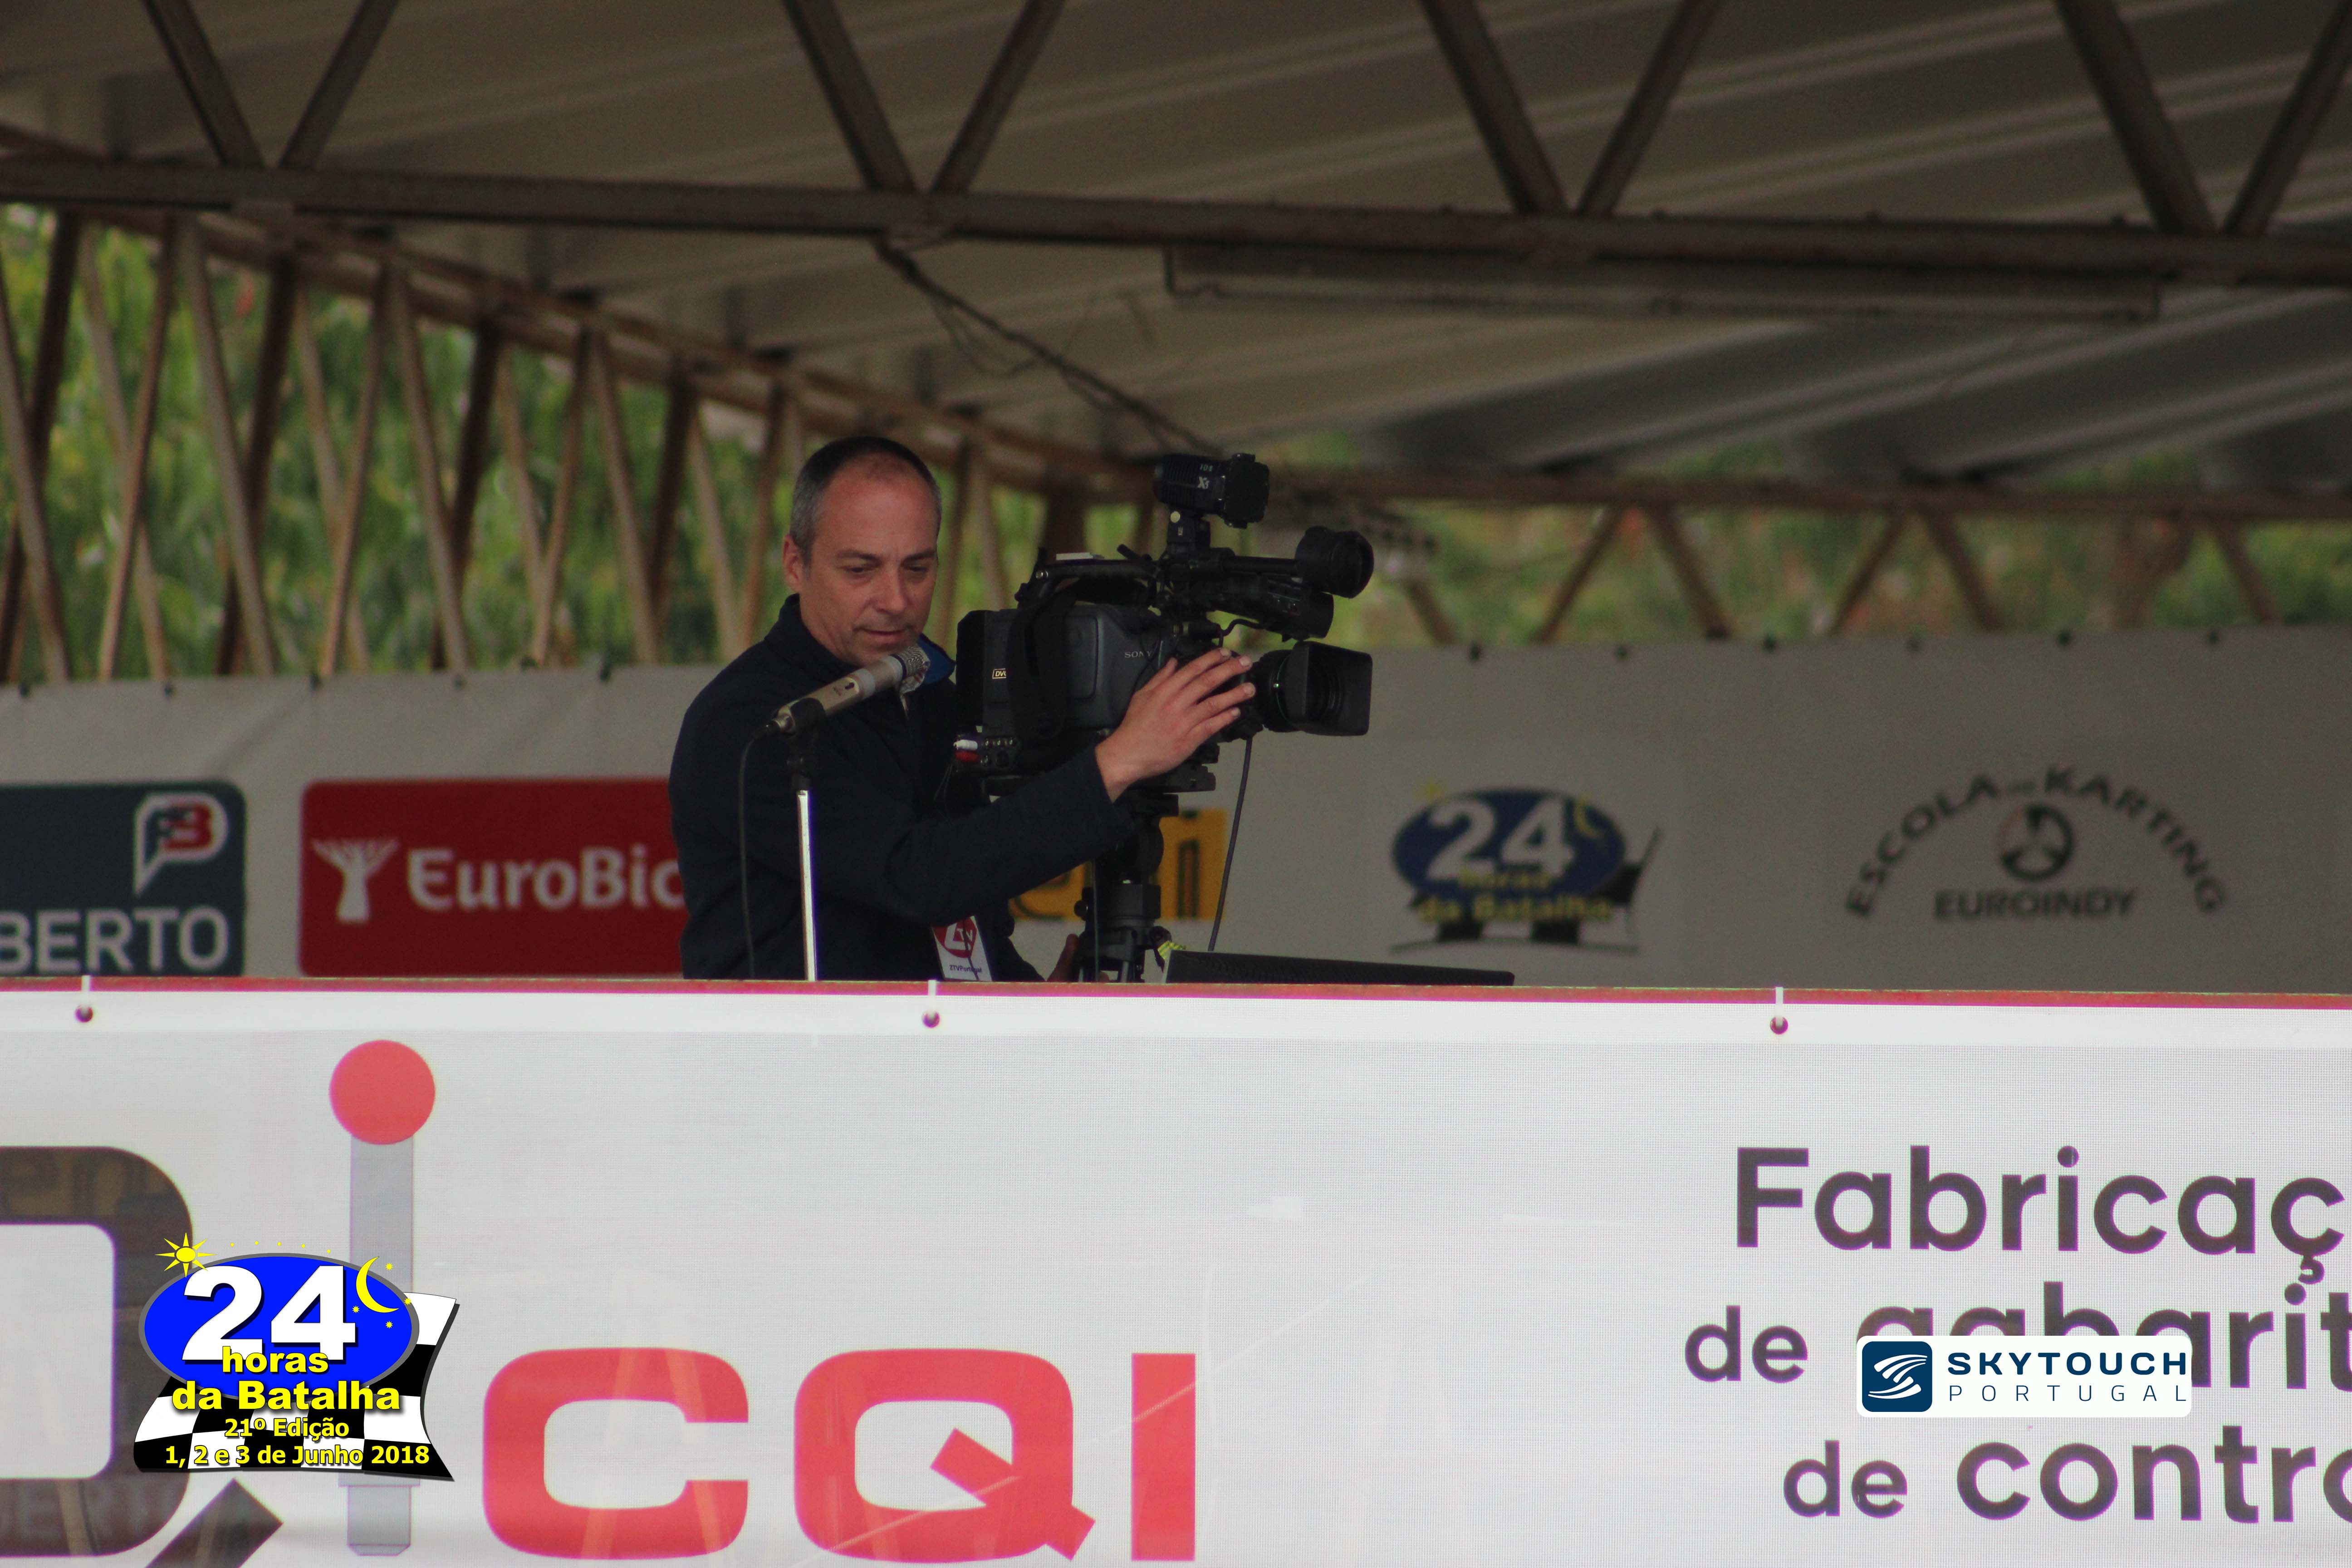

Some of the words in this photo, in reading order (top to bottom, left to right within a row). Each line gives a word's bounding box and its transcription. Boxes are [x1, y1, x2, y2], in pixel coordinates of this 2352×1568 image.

[1124, 650, 1153, 658] SONY
[1426, 797, 1575, 883] 24
[1845, 774, 1998, 919] ESCOLA
[2044, 764, 2226, 913] KARTING
[0, 909, 229, 974] BERTO
[1933, 888, 2136, 921] EUROINDY
[949, 964, 982, 973] ZTVPortal
[1737, 1145, 2345, 1285] Fabricaç
[1684, 1305, 1808, 1383] de
[483, 1346, 1196, 1563] CQI
[1783, 1440, 1907, 1519] de
